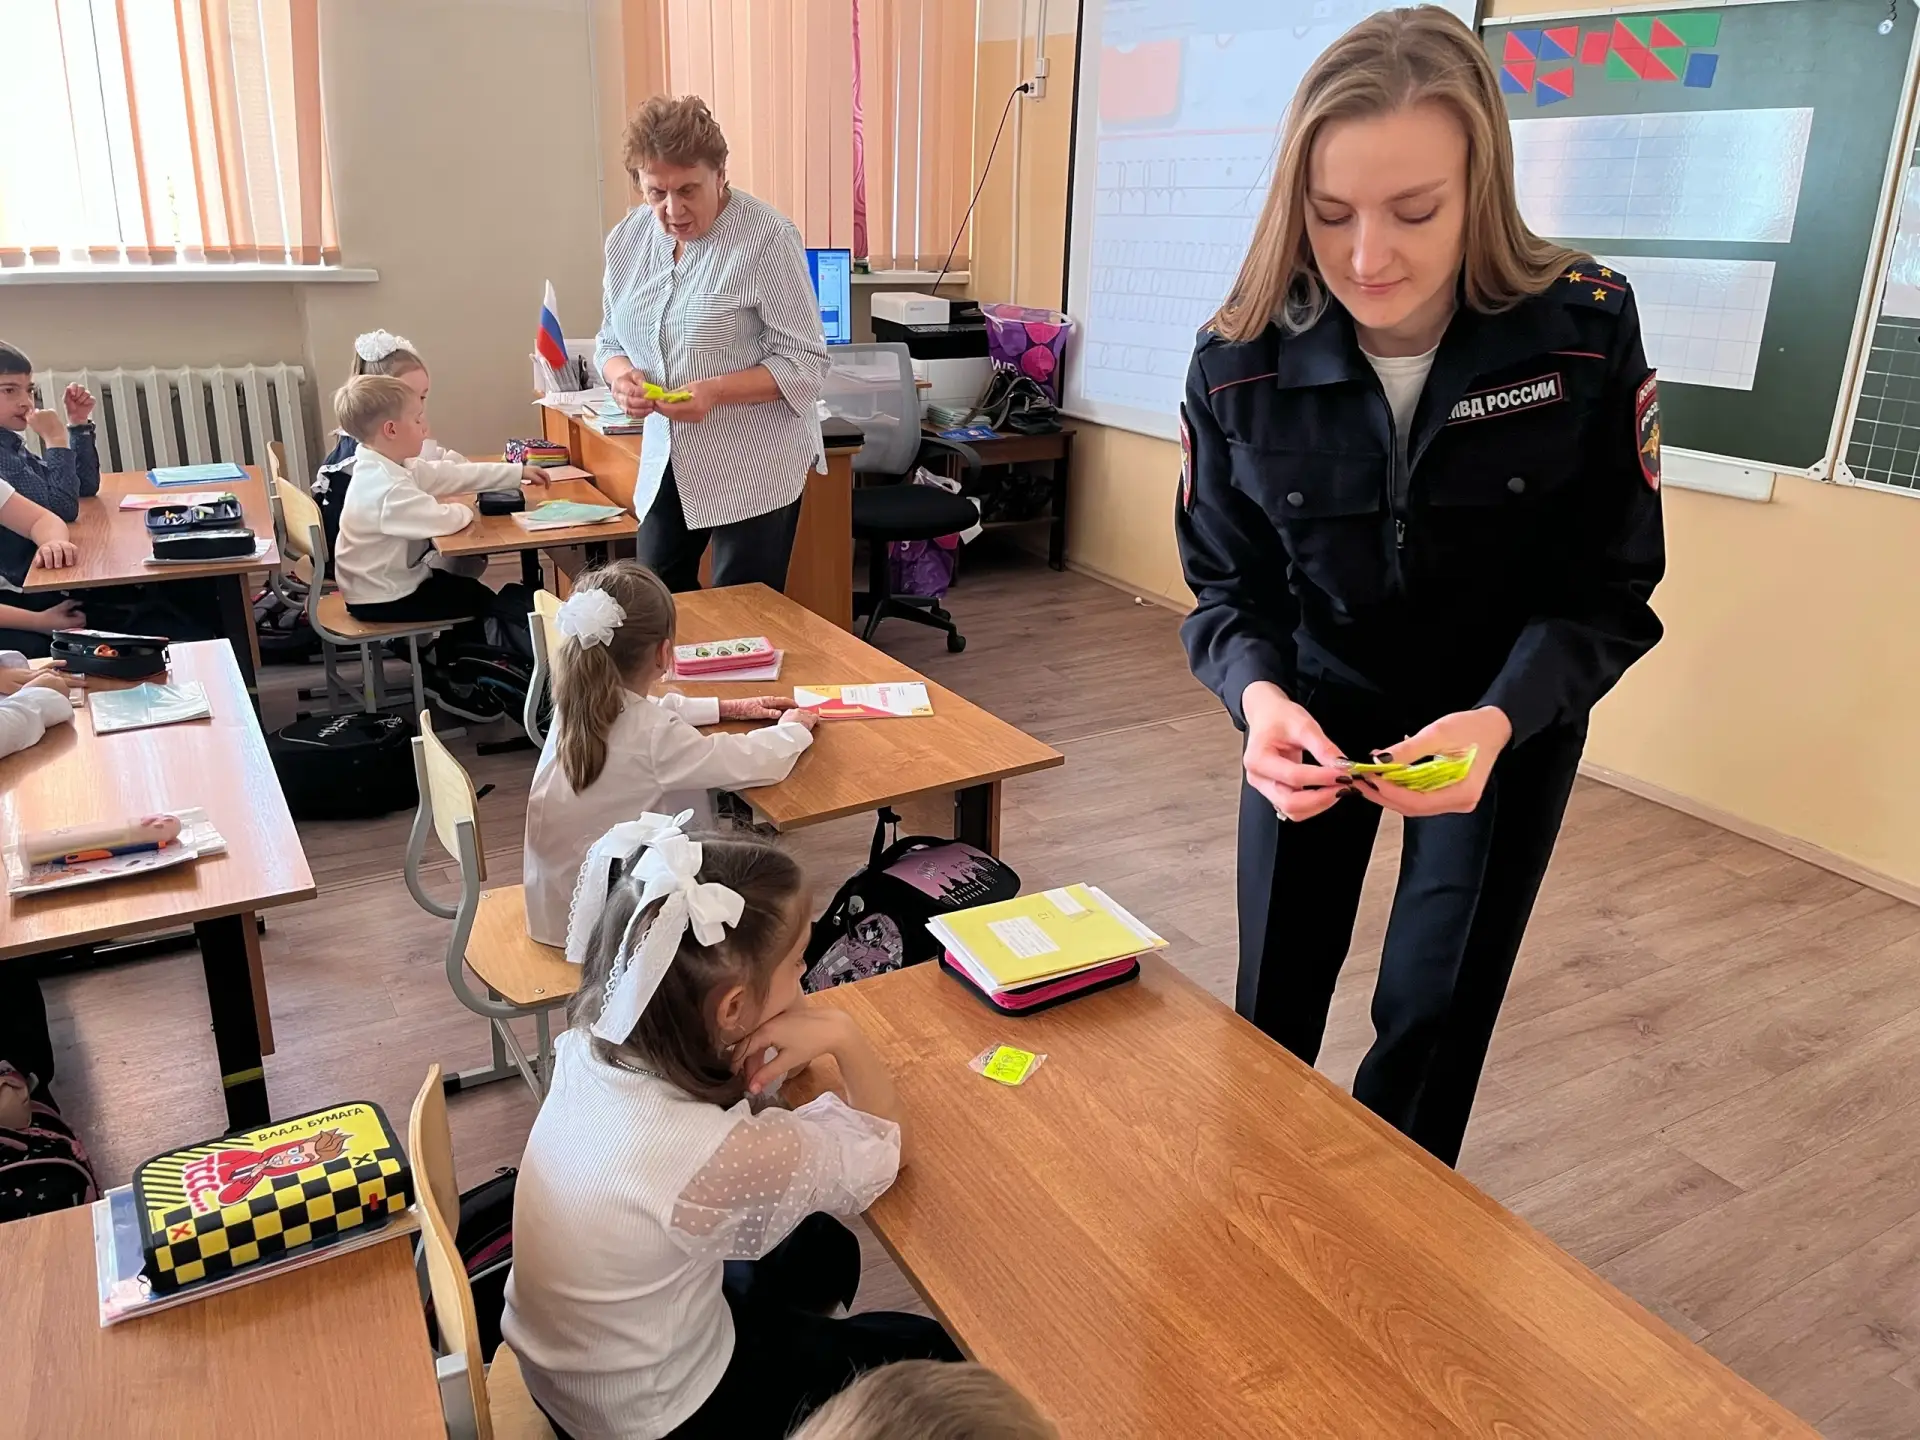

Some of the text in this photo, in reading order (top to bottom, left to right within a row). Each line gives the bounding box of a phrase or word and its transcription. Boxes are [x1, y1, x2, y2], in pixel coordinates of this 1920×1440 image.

[1486, 379, 1556, 412] РОССИИ
[258, 1107, 365, 1142] ВЛАД БУМАГА
